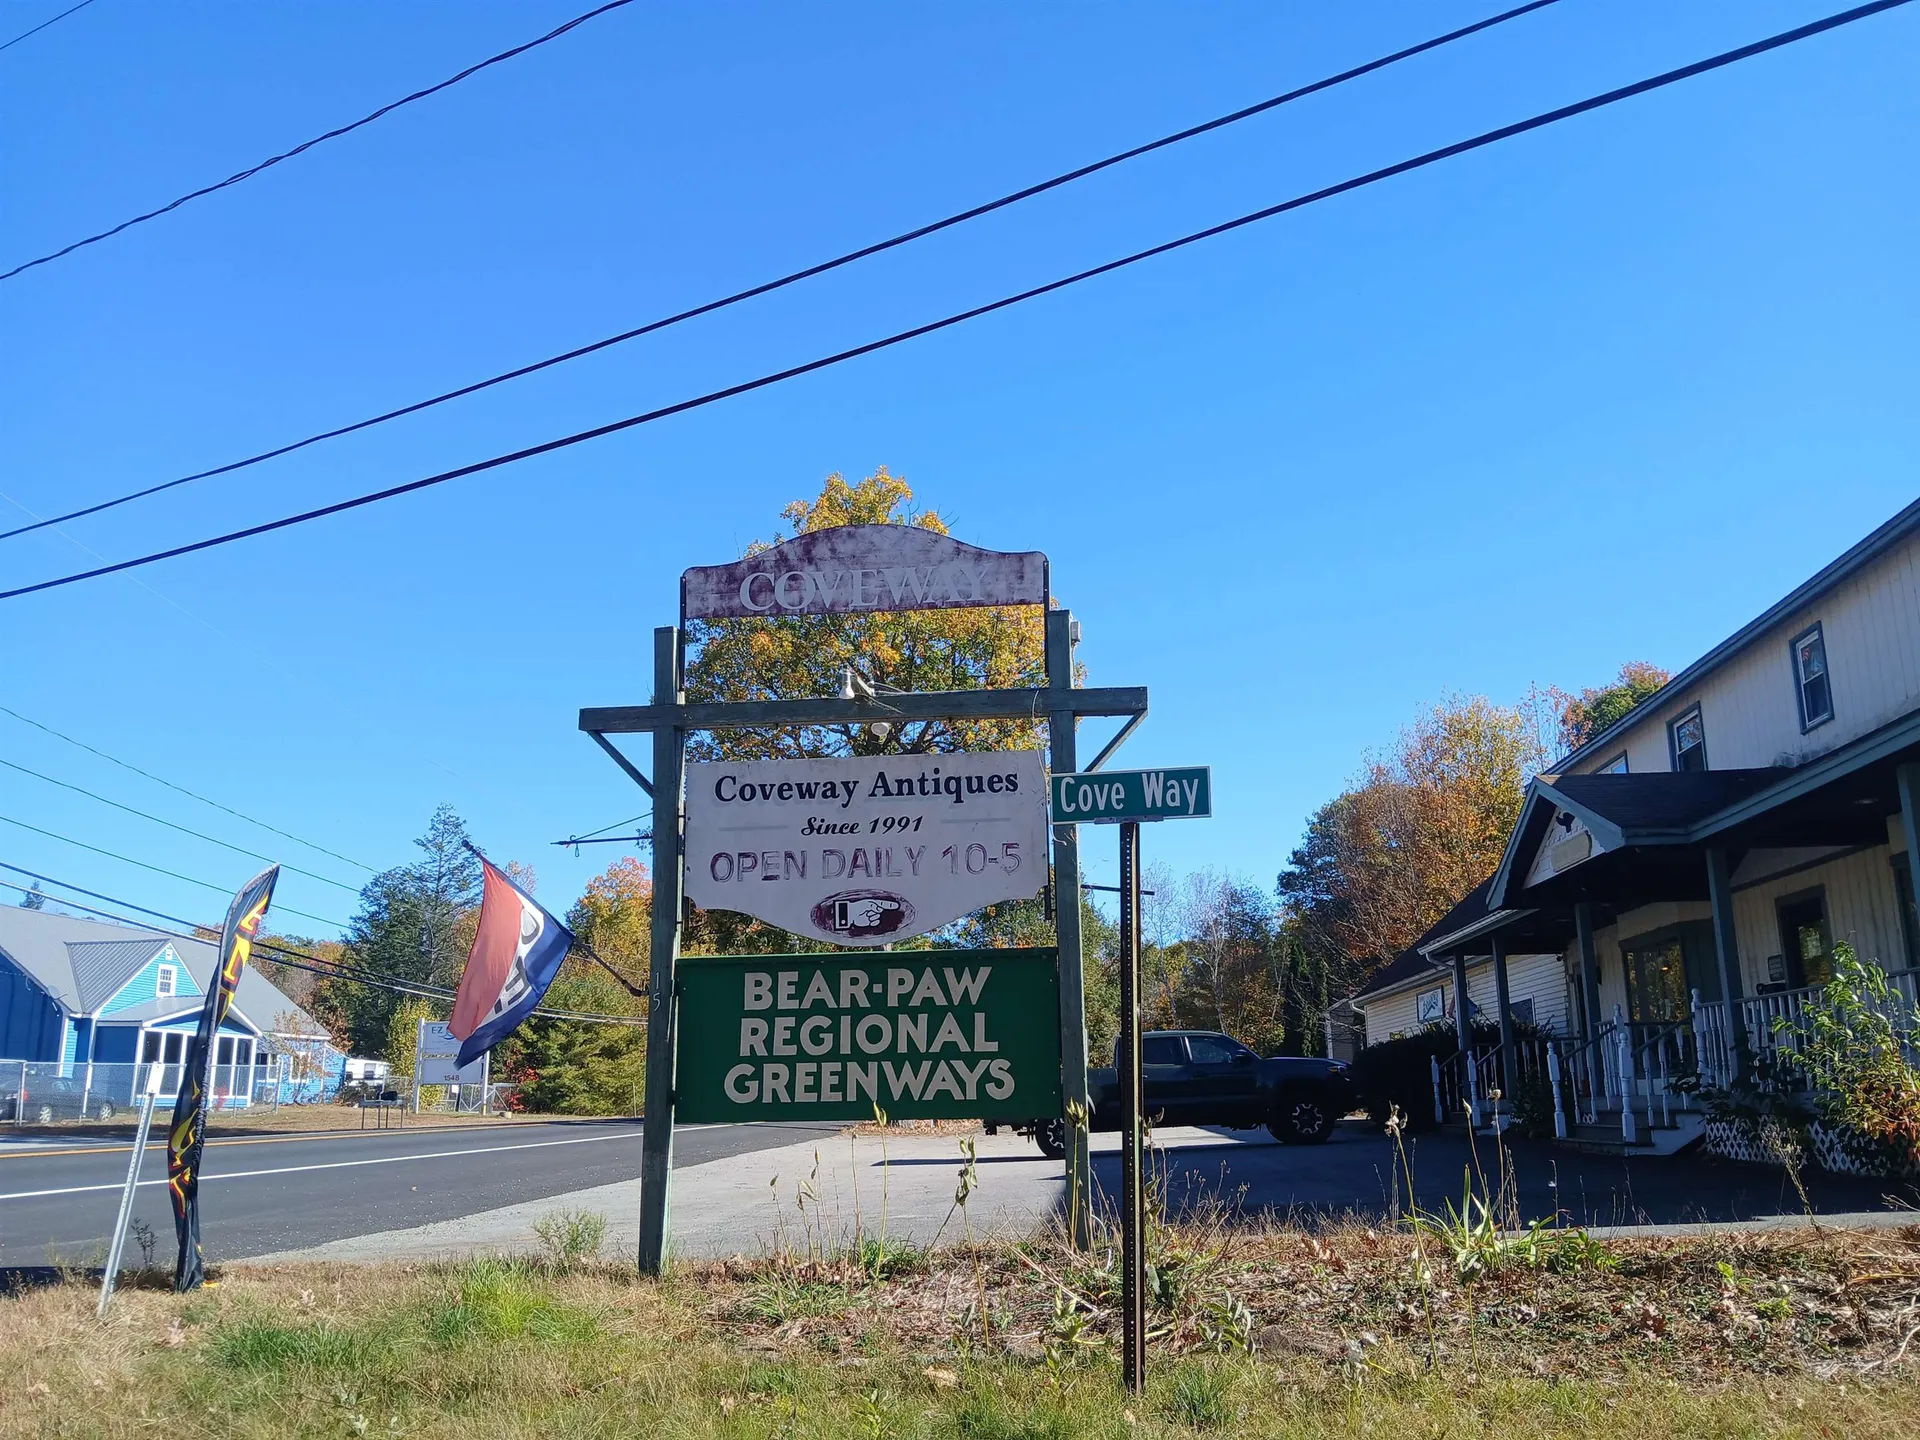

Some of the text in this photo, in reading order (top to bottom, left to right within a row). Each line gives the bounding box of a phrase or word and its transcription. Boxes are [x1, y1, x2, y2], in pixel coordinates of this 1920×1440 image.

[739, 563, 994, 612] COVEWAY
[715, 767, 1019, 808] Coveway Antiques
[1060, 771, 1199, 815] Cove Way
[801, 815, 924, 836] Since 1991
[710, 842, 1022, 883] OPEN DAILY 10-5
[739, 1011, 999, 1057] REGIONAL
[723, 1058, 1015, 1104] GREENWAYS
